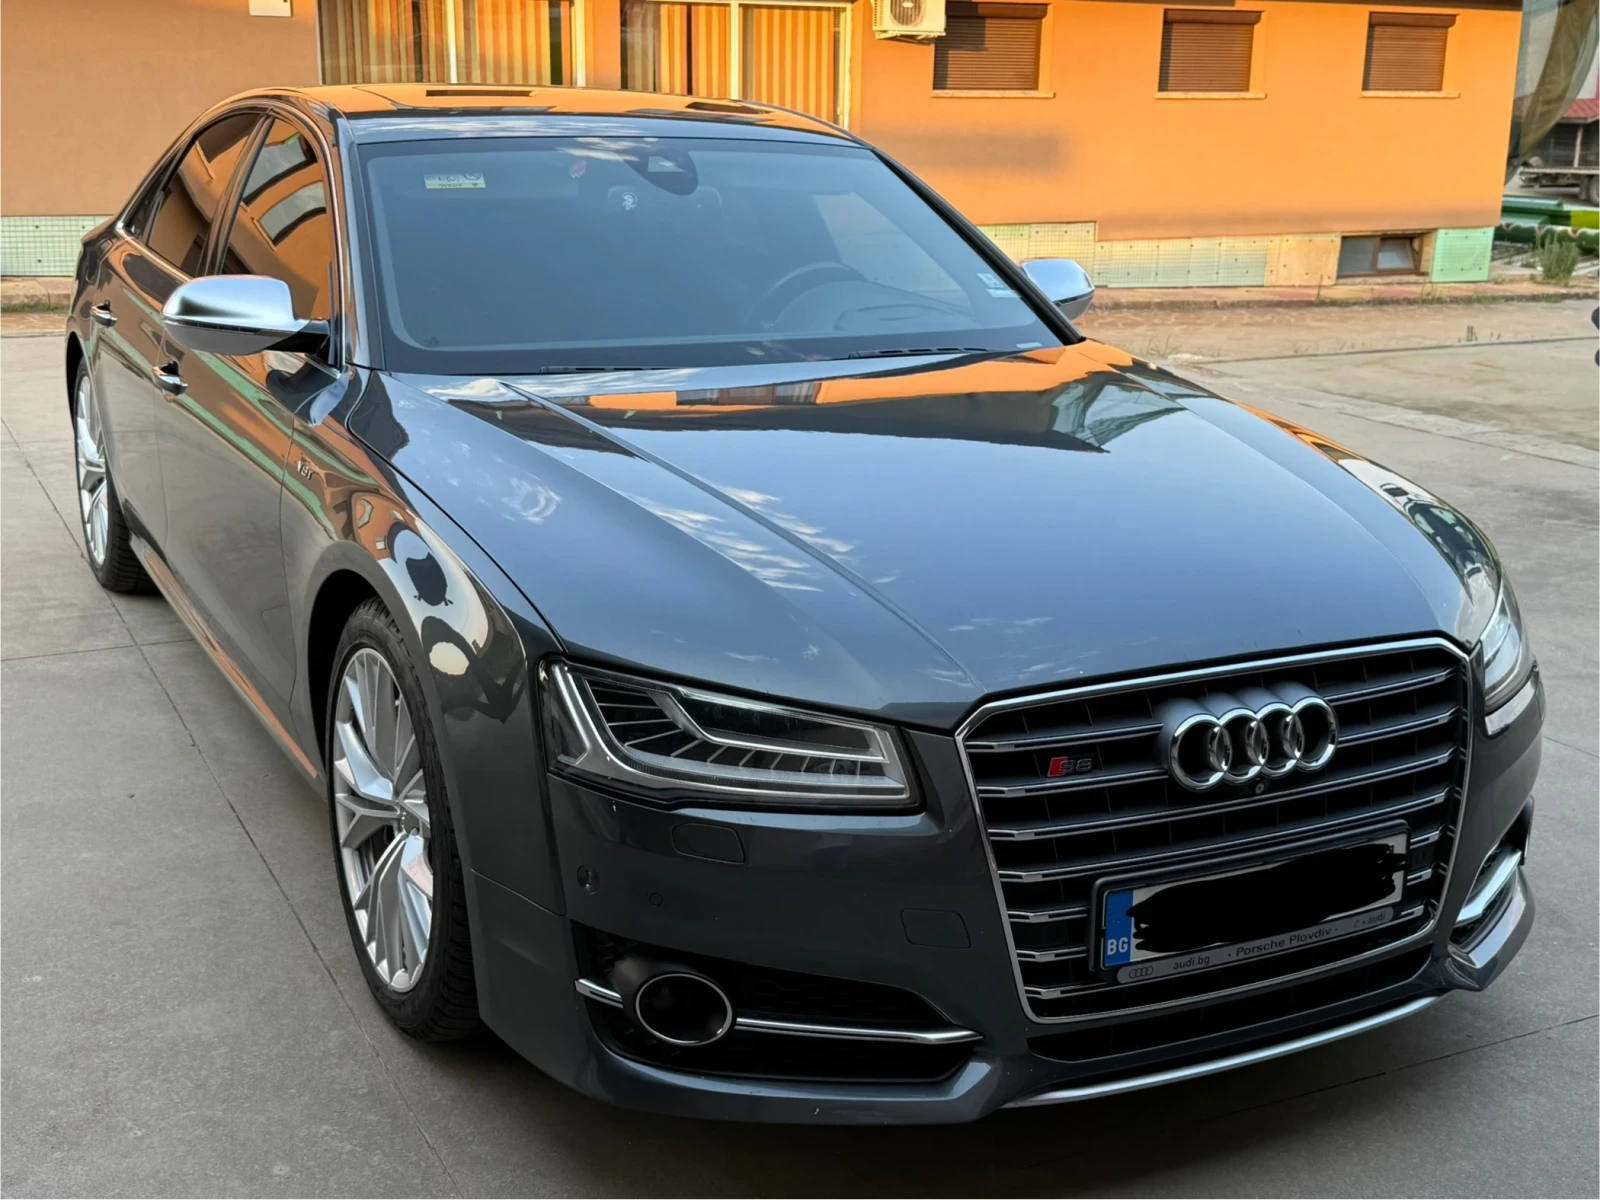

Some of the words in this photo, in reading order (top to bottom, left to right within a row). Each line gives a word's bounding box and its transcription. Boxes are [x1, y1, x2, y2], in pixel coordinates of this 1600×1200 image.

[1059, 758, 1092, 774] S8
[1106, 937, 1129, 956] BG
[1173, 956, 1210, 970] audi.bg
[1236, 939, 1286, 957] Porsche
[1289, 927, 1333, 945] Plovdiv
